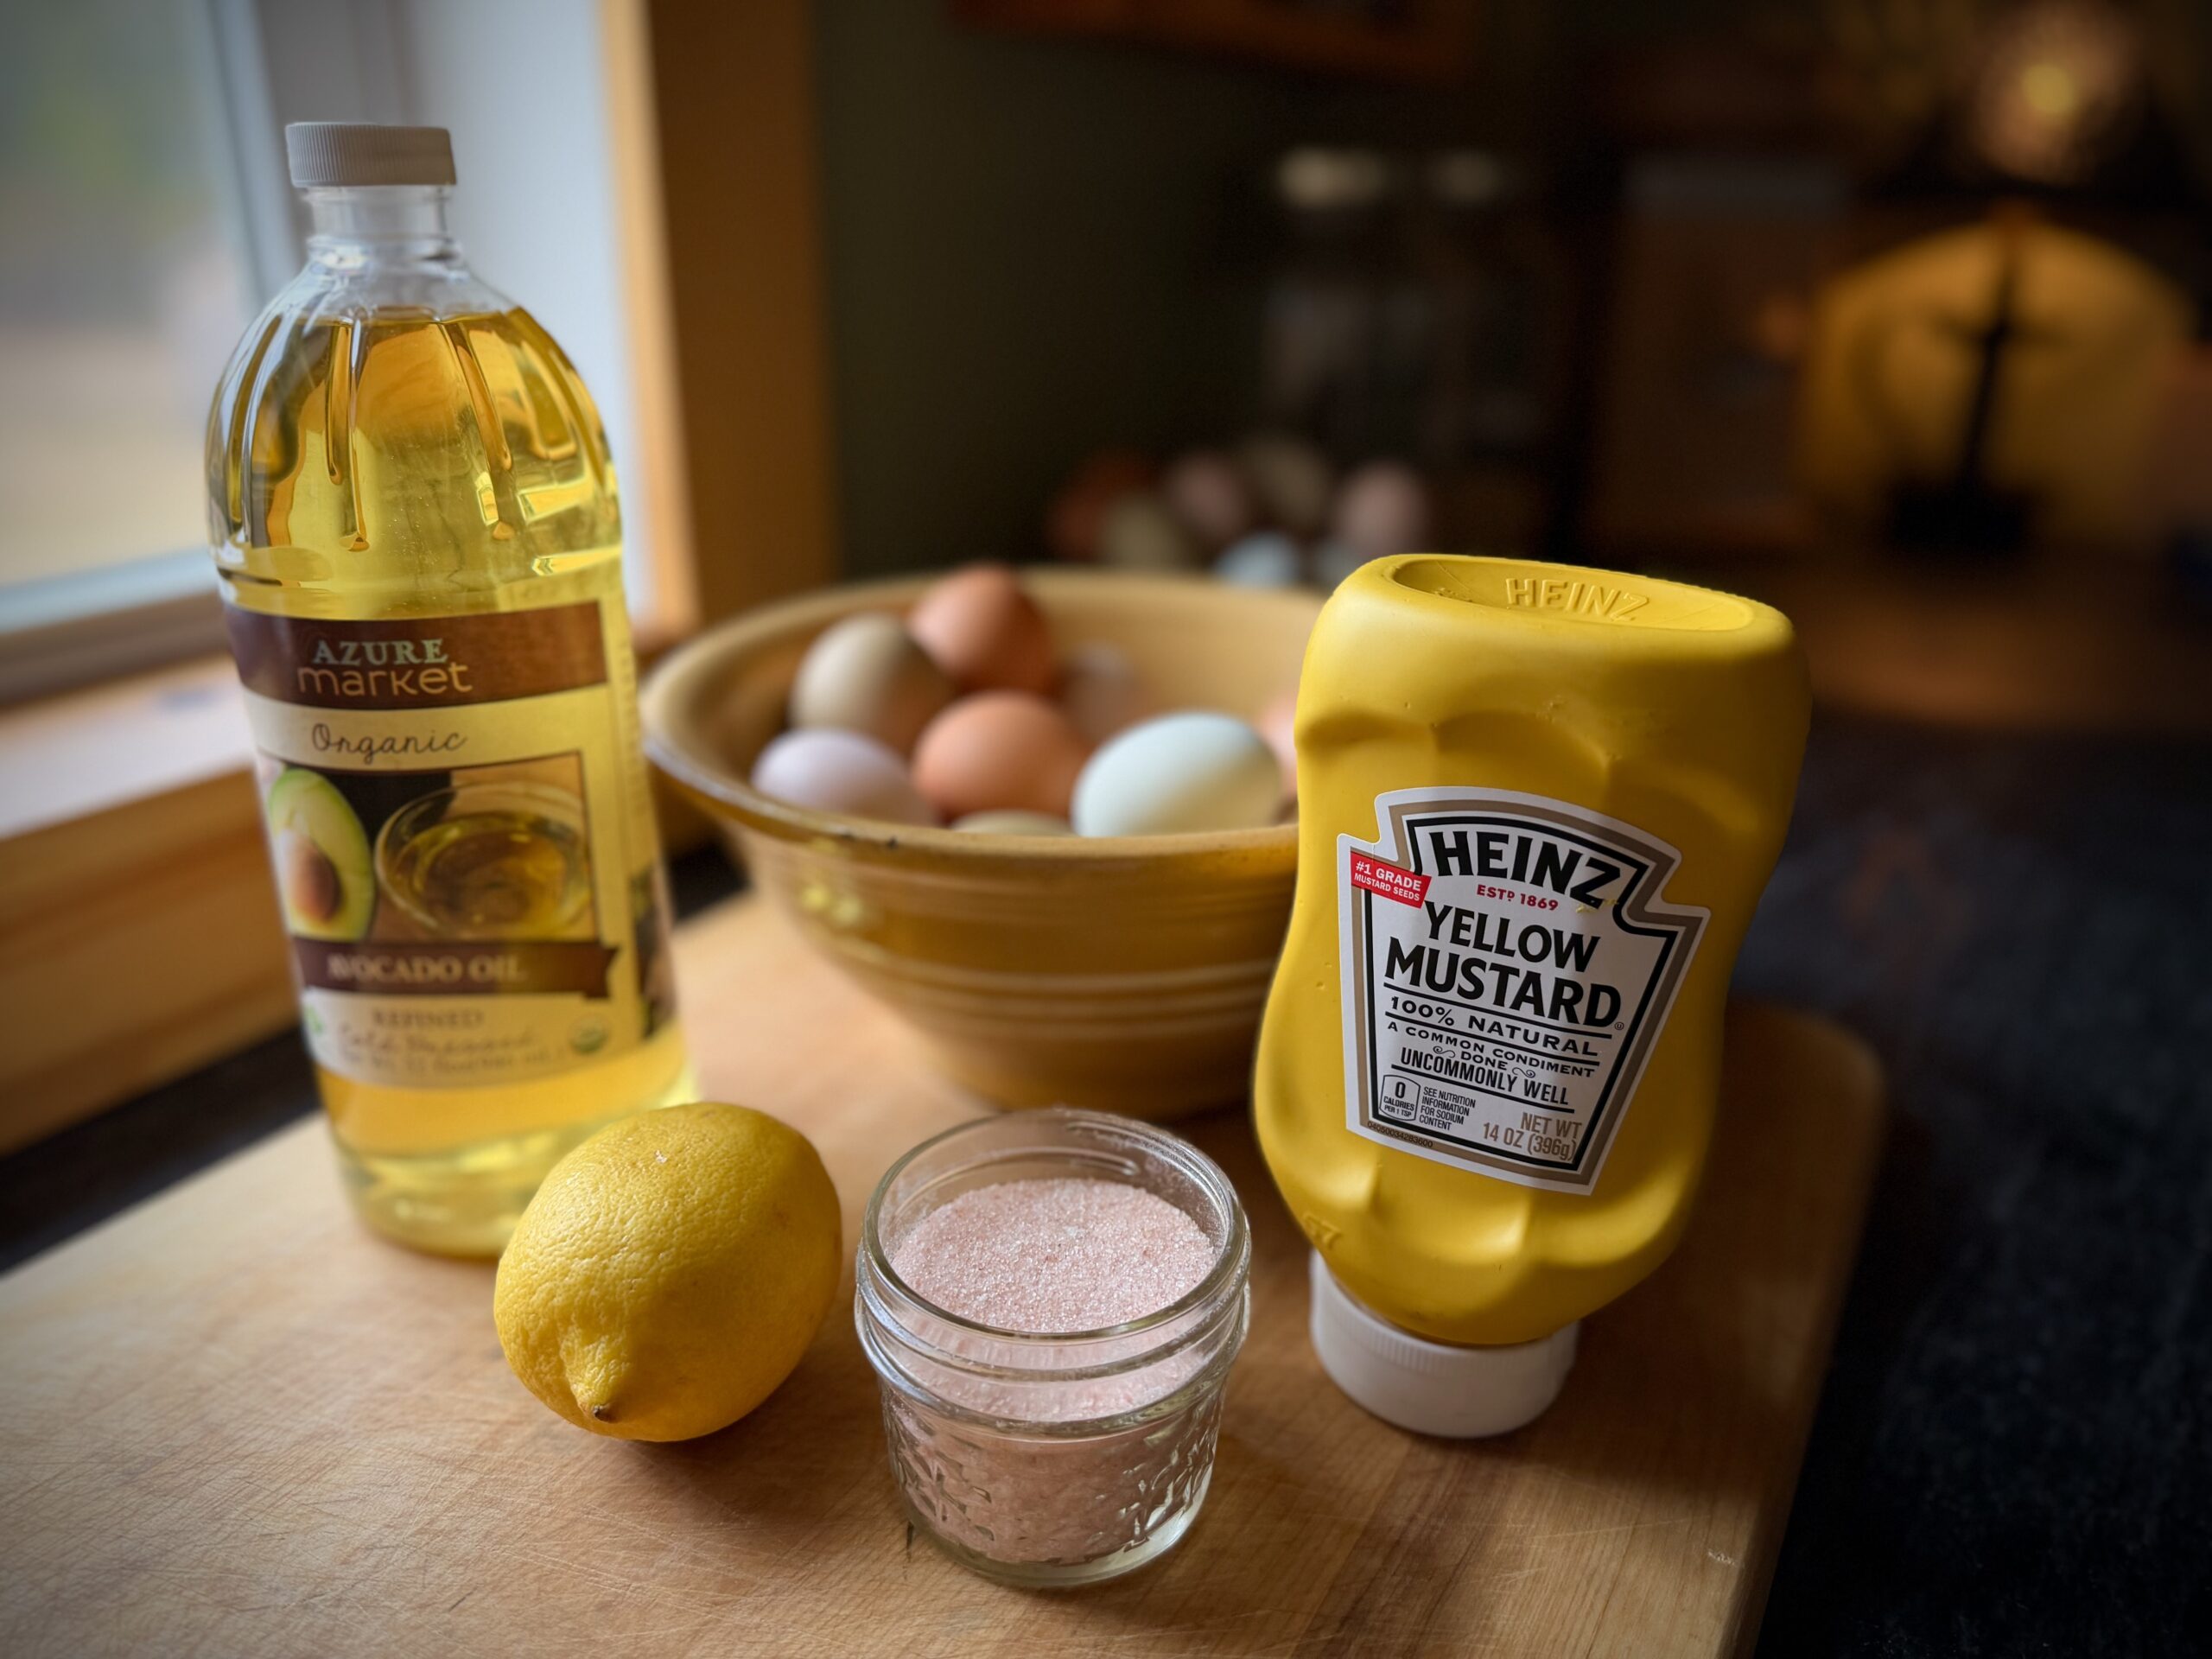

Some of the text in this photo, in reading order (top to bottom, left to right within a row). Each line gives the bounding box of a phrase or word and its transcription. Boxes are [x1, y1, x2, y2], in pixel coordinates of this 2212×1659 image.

[1506, 578, 1649, 621] HEINZ
[312, 639, 448, 666] AZURE
[297, 662, 473, 696] market
[312, 722, 468, 766] Organic
[1355, 861, 1422, 892] #1 GRADE
[1429, 830, 1621, 910] HEINZ
[1354, 873, 1420, 902] MUSTARD SEEDS
[1520, 893, 1559, 911] 1869
[1424, 901, 1601, 972] YELLOW
[327, 953, 529, 983] AVOCADO OIL
[1383, 937, 1622, 1027] MUSTARD
[1390, 996, 1599, 1057] 100% NATURAL
[1388, 1021, 1595, 1077] A COMMON CONDIMENT
[1461, 1051, 1508, 1071] DONE
[1395, 1081, 1406, 1099] 0
[1401, 1047, 1568, 1106] UNCOMMONLY WELL
[1383, 1096, 1414, 1112] CALORIES
[1384, 1105, 1395, 1114] PER
[1401, 1108, 1412, 1117] TSP
[1422, 1096, 1470, 1116] INFORMATION
[1423, 1087, 1476, 1108] SEE NUTRITION
[1419, 1115, 1452, 1131] CONTENT
[1421, 1105, 1465, 1125] FOR SODIUM
[1521, 1112, 1582, 1139] NET WT
[1483, 1122, 1577, 1161] 14 OZ (396g)
